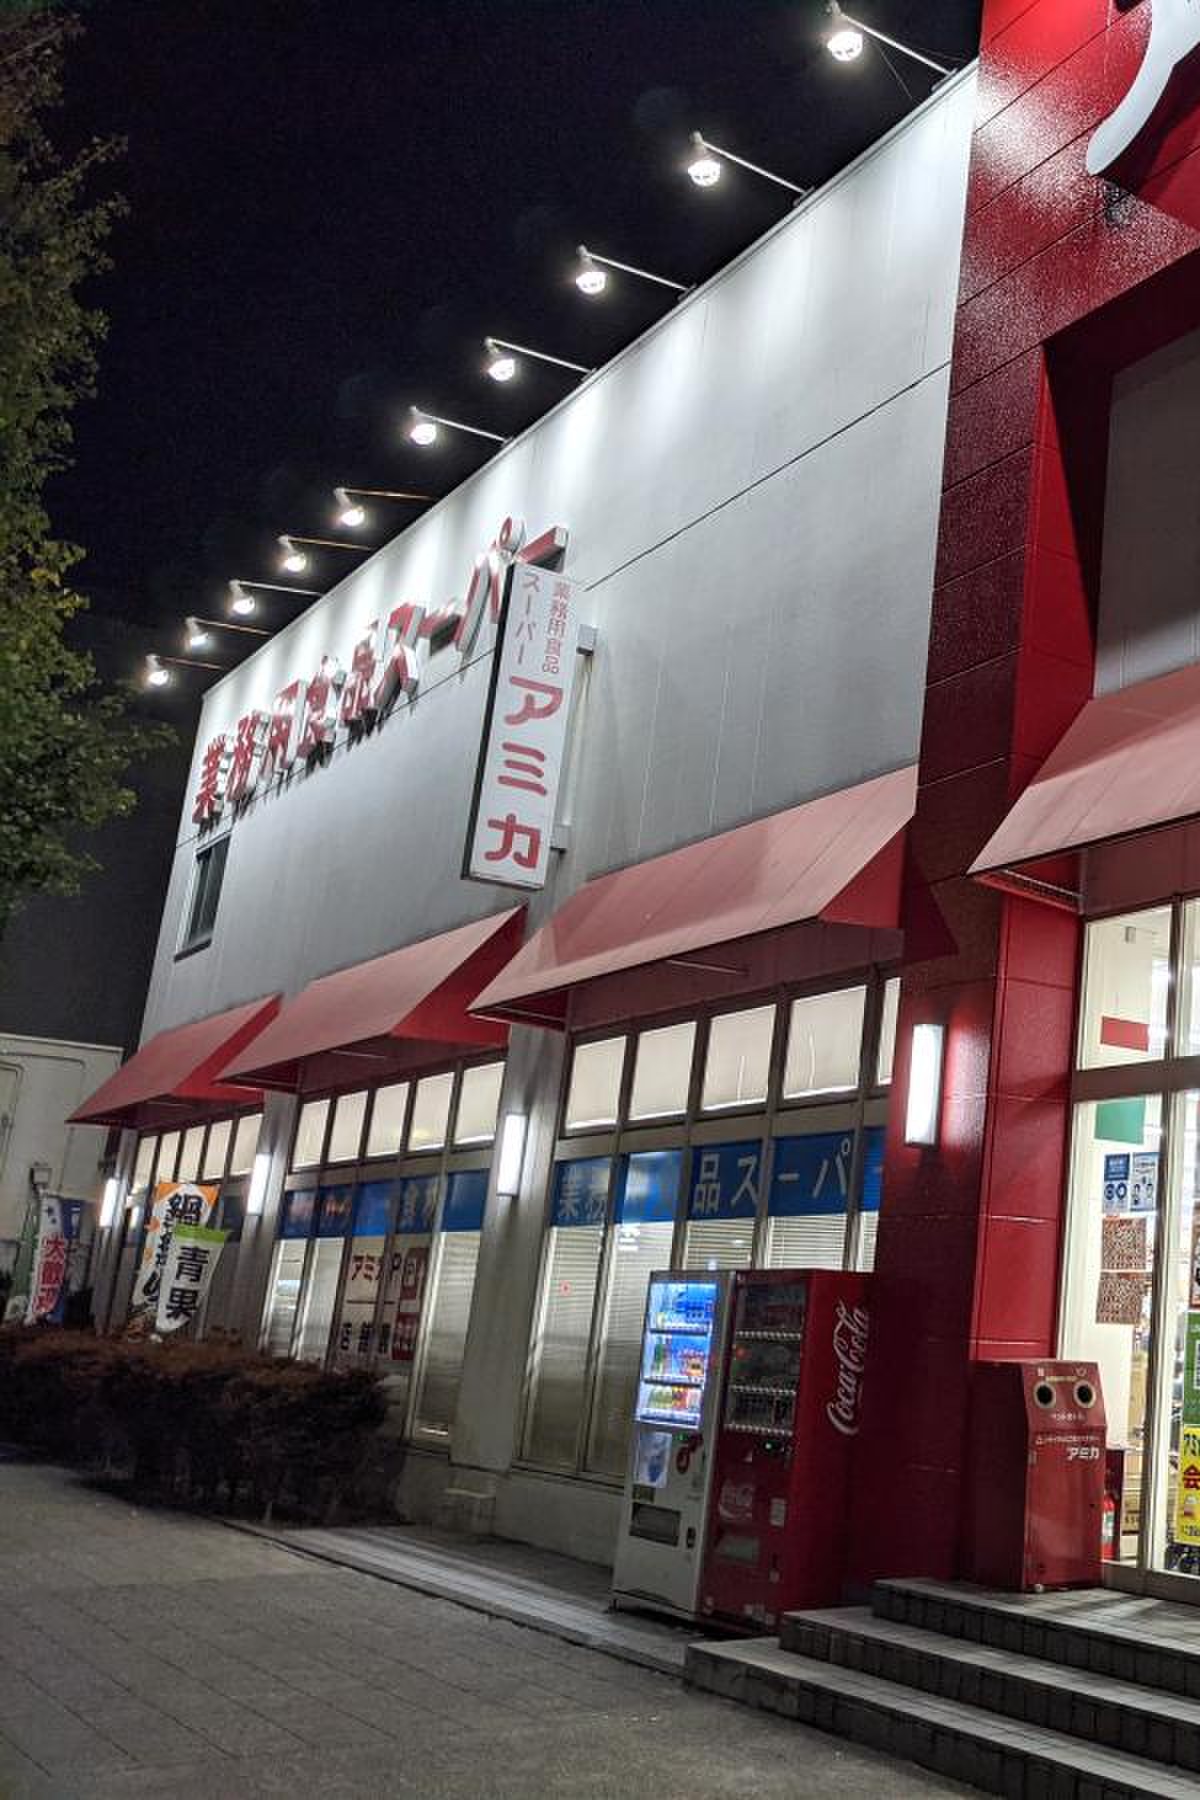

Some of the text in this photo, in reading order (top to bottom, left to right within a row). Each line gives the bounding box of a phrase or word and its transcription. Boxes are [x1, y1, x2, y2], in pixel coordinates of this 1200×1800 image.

[517, 573, 541, 665] スーパー
[485, 675, 563, 870] アミカ
[166, 1246, 210, 1321] 青果
[1066, 1447, 1099, 1461] アミカ
